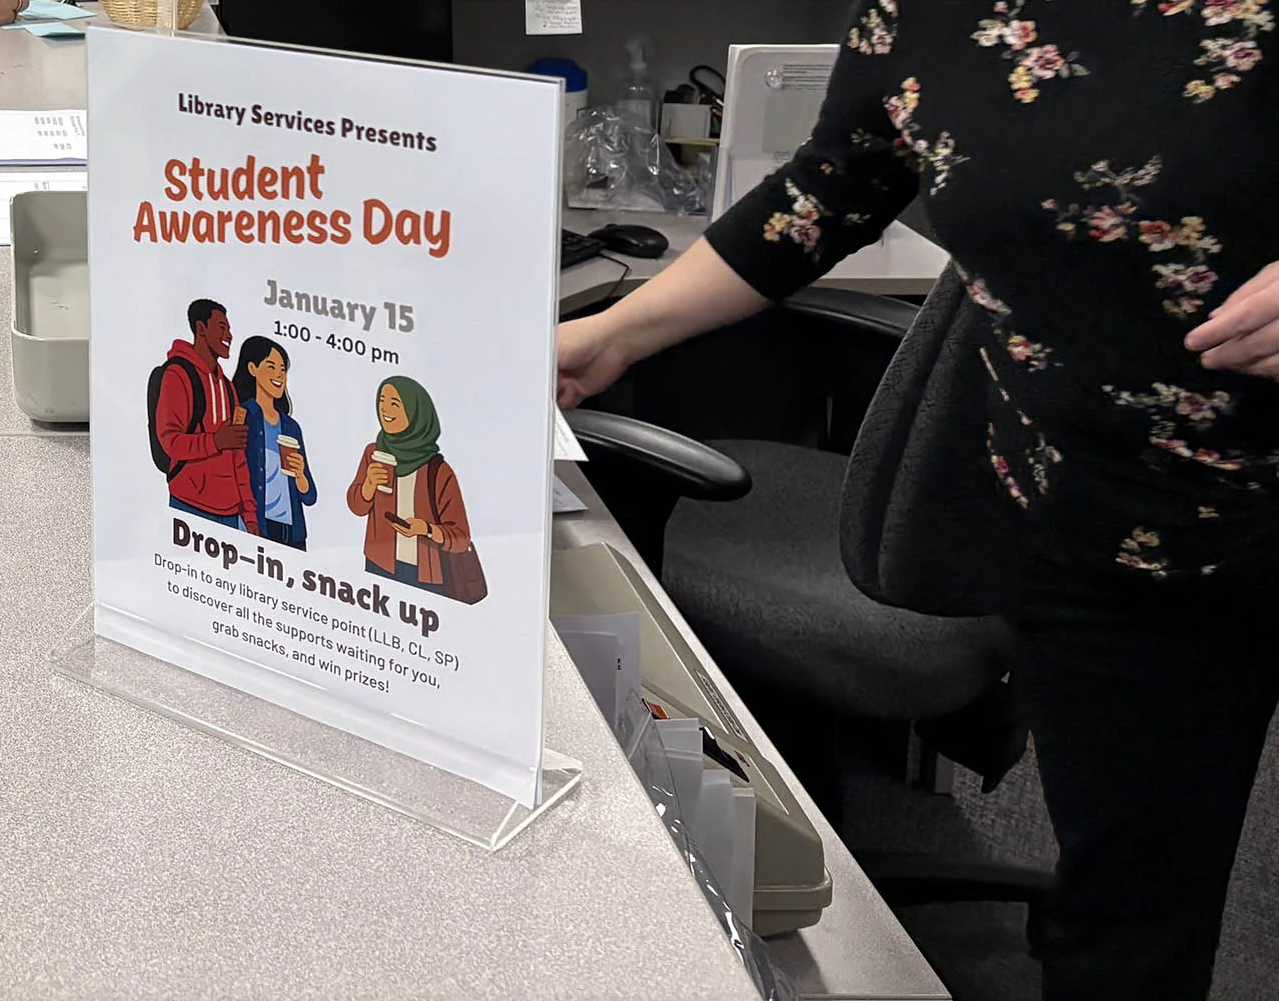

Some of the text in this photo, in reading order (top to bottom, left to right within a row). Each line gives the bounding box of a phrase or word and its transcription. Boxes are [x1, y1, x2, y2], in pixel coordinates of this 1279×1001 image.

[179, 93, 437, 152] Library Services Presents
[165, 154, 325, 201] Student
[133, 199, 451, 258] Awareness Day
[264, 280, 413, 332] January 15
[274, 321, 310, 343] 1:00
[326, 334, 365, 357] 4:00
[372, 347, 399, 364] pm
[173, 517, 439, 638] Drop-in, snack up
[155, 553, 459, 671] Drop-in to any library service point (LLB, CL, SP)
[168, 581, 440, 689] to discover all the supports waiting for you,
[213, 621, 389, 693] grab snacks, and win prizes!
